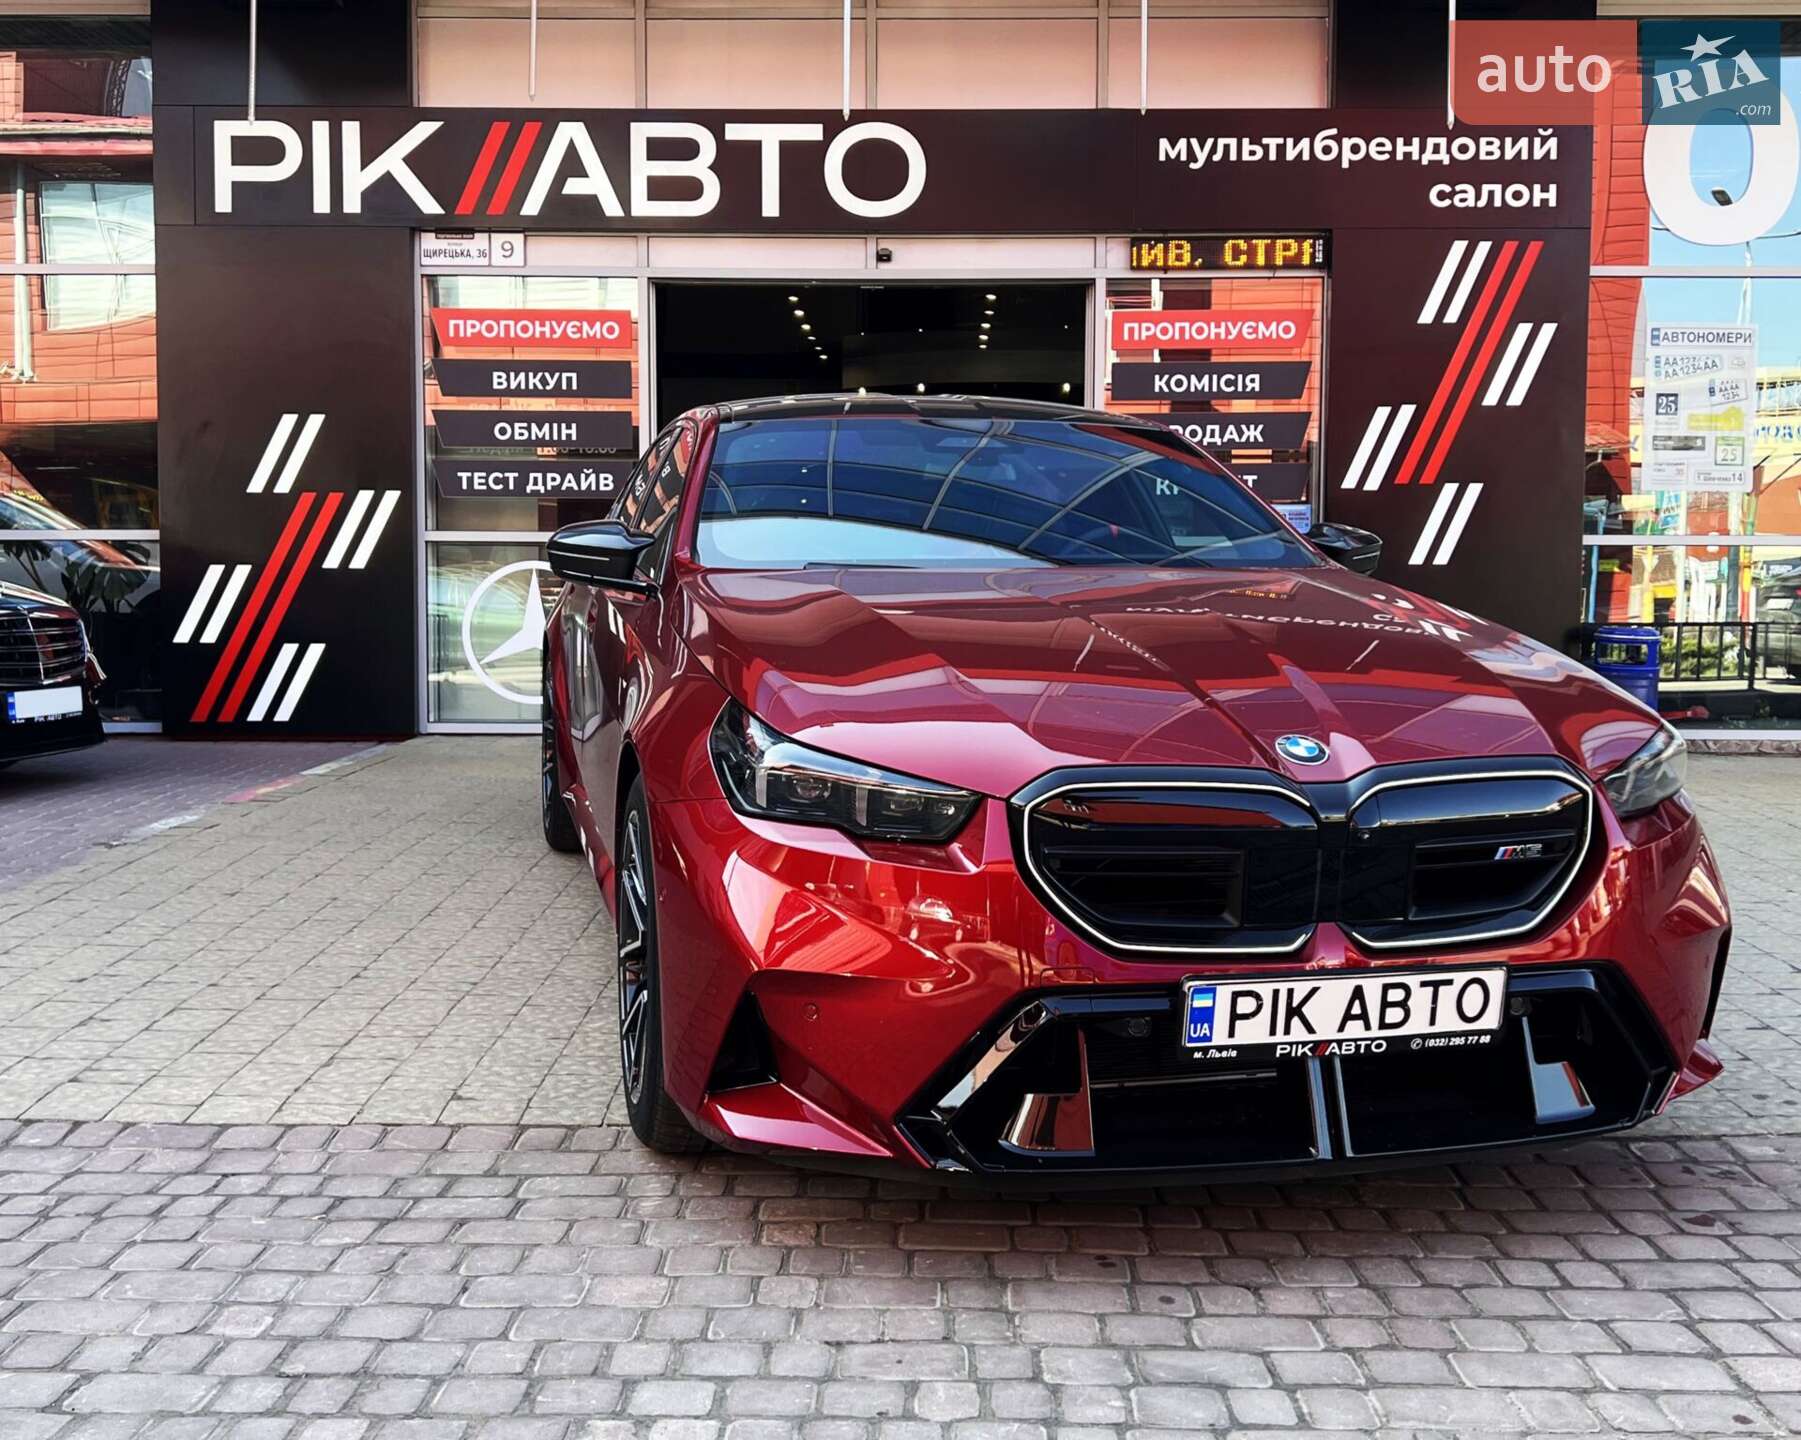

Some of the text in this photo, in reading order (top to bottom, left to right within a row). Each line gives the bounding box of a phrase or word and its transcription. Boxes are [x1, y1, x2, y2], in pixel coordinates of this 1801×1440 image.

[1158, 128, 1558, 169] мультибрендовий
[1429, 182, 1558, 208] салон
[501, 240, 514, 258] 9
[448, 319, 620, 340] ПРОПОНУЄМО
[1122, 320, 1296, 341] ПРОПОНУЄМО
[1661, 331, 1752, 344] АВТОНОМЕРИ
[492, 371, 578, 391] ВИКУП
[1154, 373, 1261, 393] КОМІСІЯ
[1658, 396, 1676, 413] 25
[493, 422, 577, 441] ОБМІН
[457, 468, 615, 493] ТЕСТ ДРАЙВ
[1228, 977, 1491, 1038] РІК АВТО
[1190, 1023, 1210, 1037] UA
